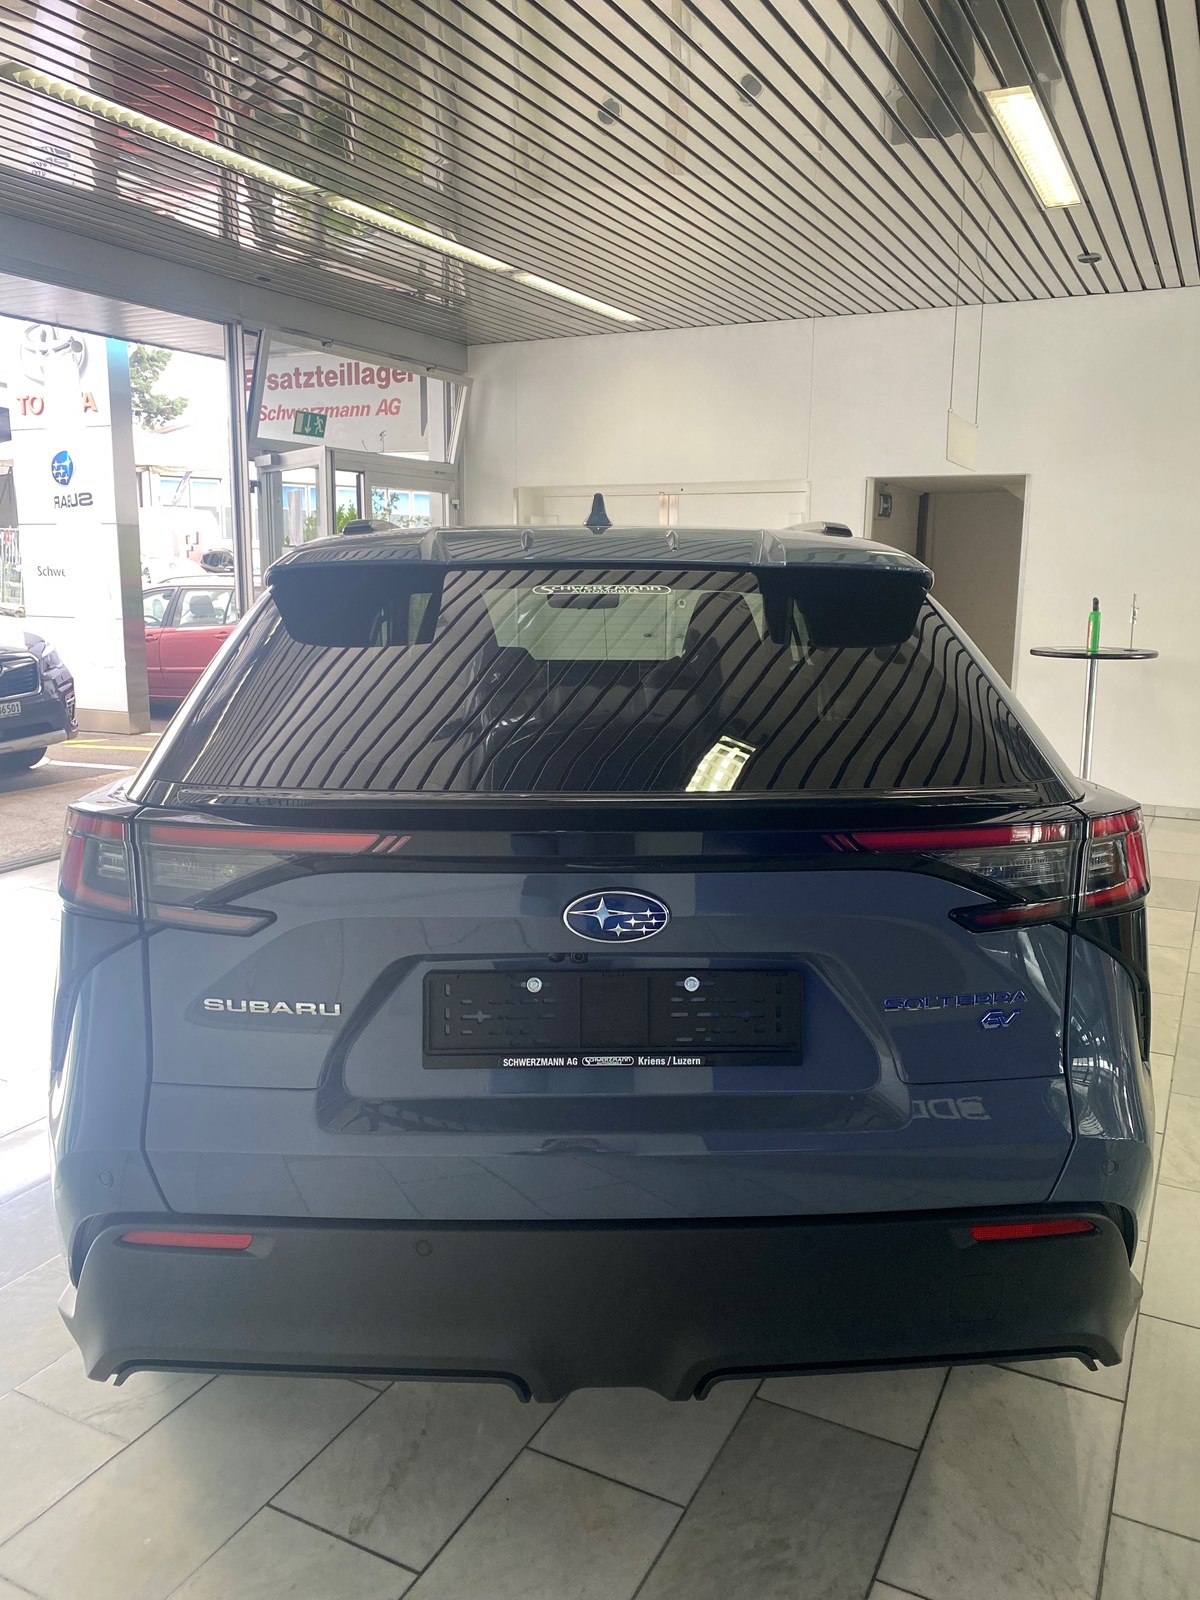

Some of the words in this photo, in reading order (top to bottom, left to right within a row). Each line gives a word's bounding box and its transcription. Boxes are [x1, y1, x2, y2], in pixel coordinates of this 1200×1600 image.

[244, 362, 413, 391] Esatzteillager
[375, 397, 401, 417] AG
[203, 998, 342, 1017] SUBARU
[883, 990, 1029, 1012] SOLTERRA
[981, 1008, 1021, 1028] EV
[503, 1057, 564, 1067] SCHWERZMANN
[566, 1057, 578, 1067] AG
[638, 1056, 666, 1066] Kriens
[673, 1056, 701, 1066] Luzern
